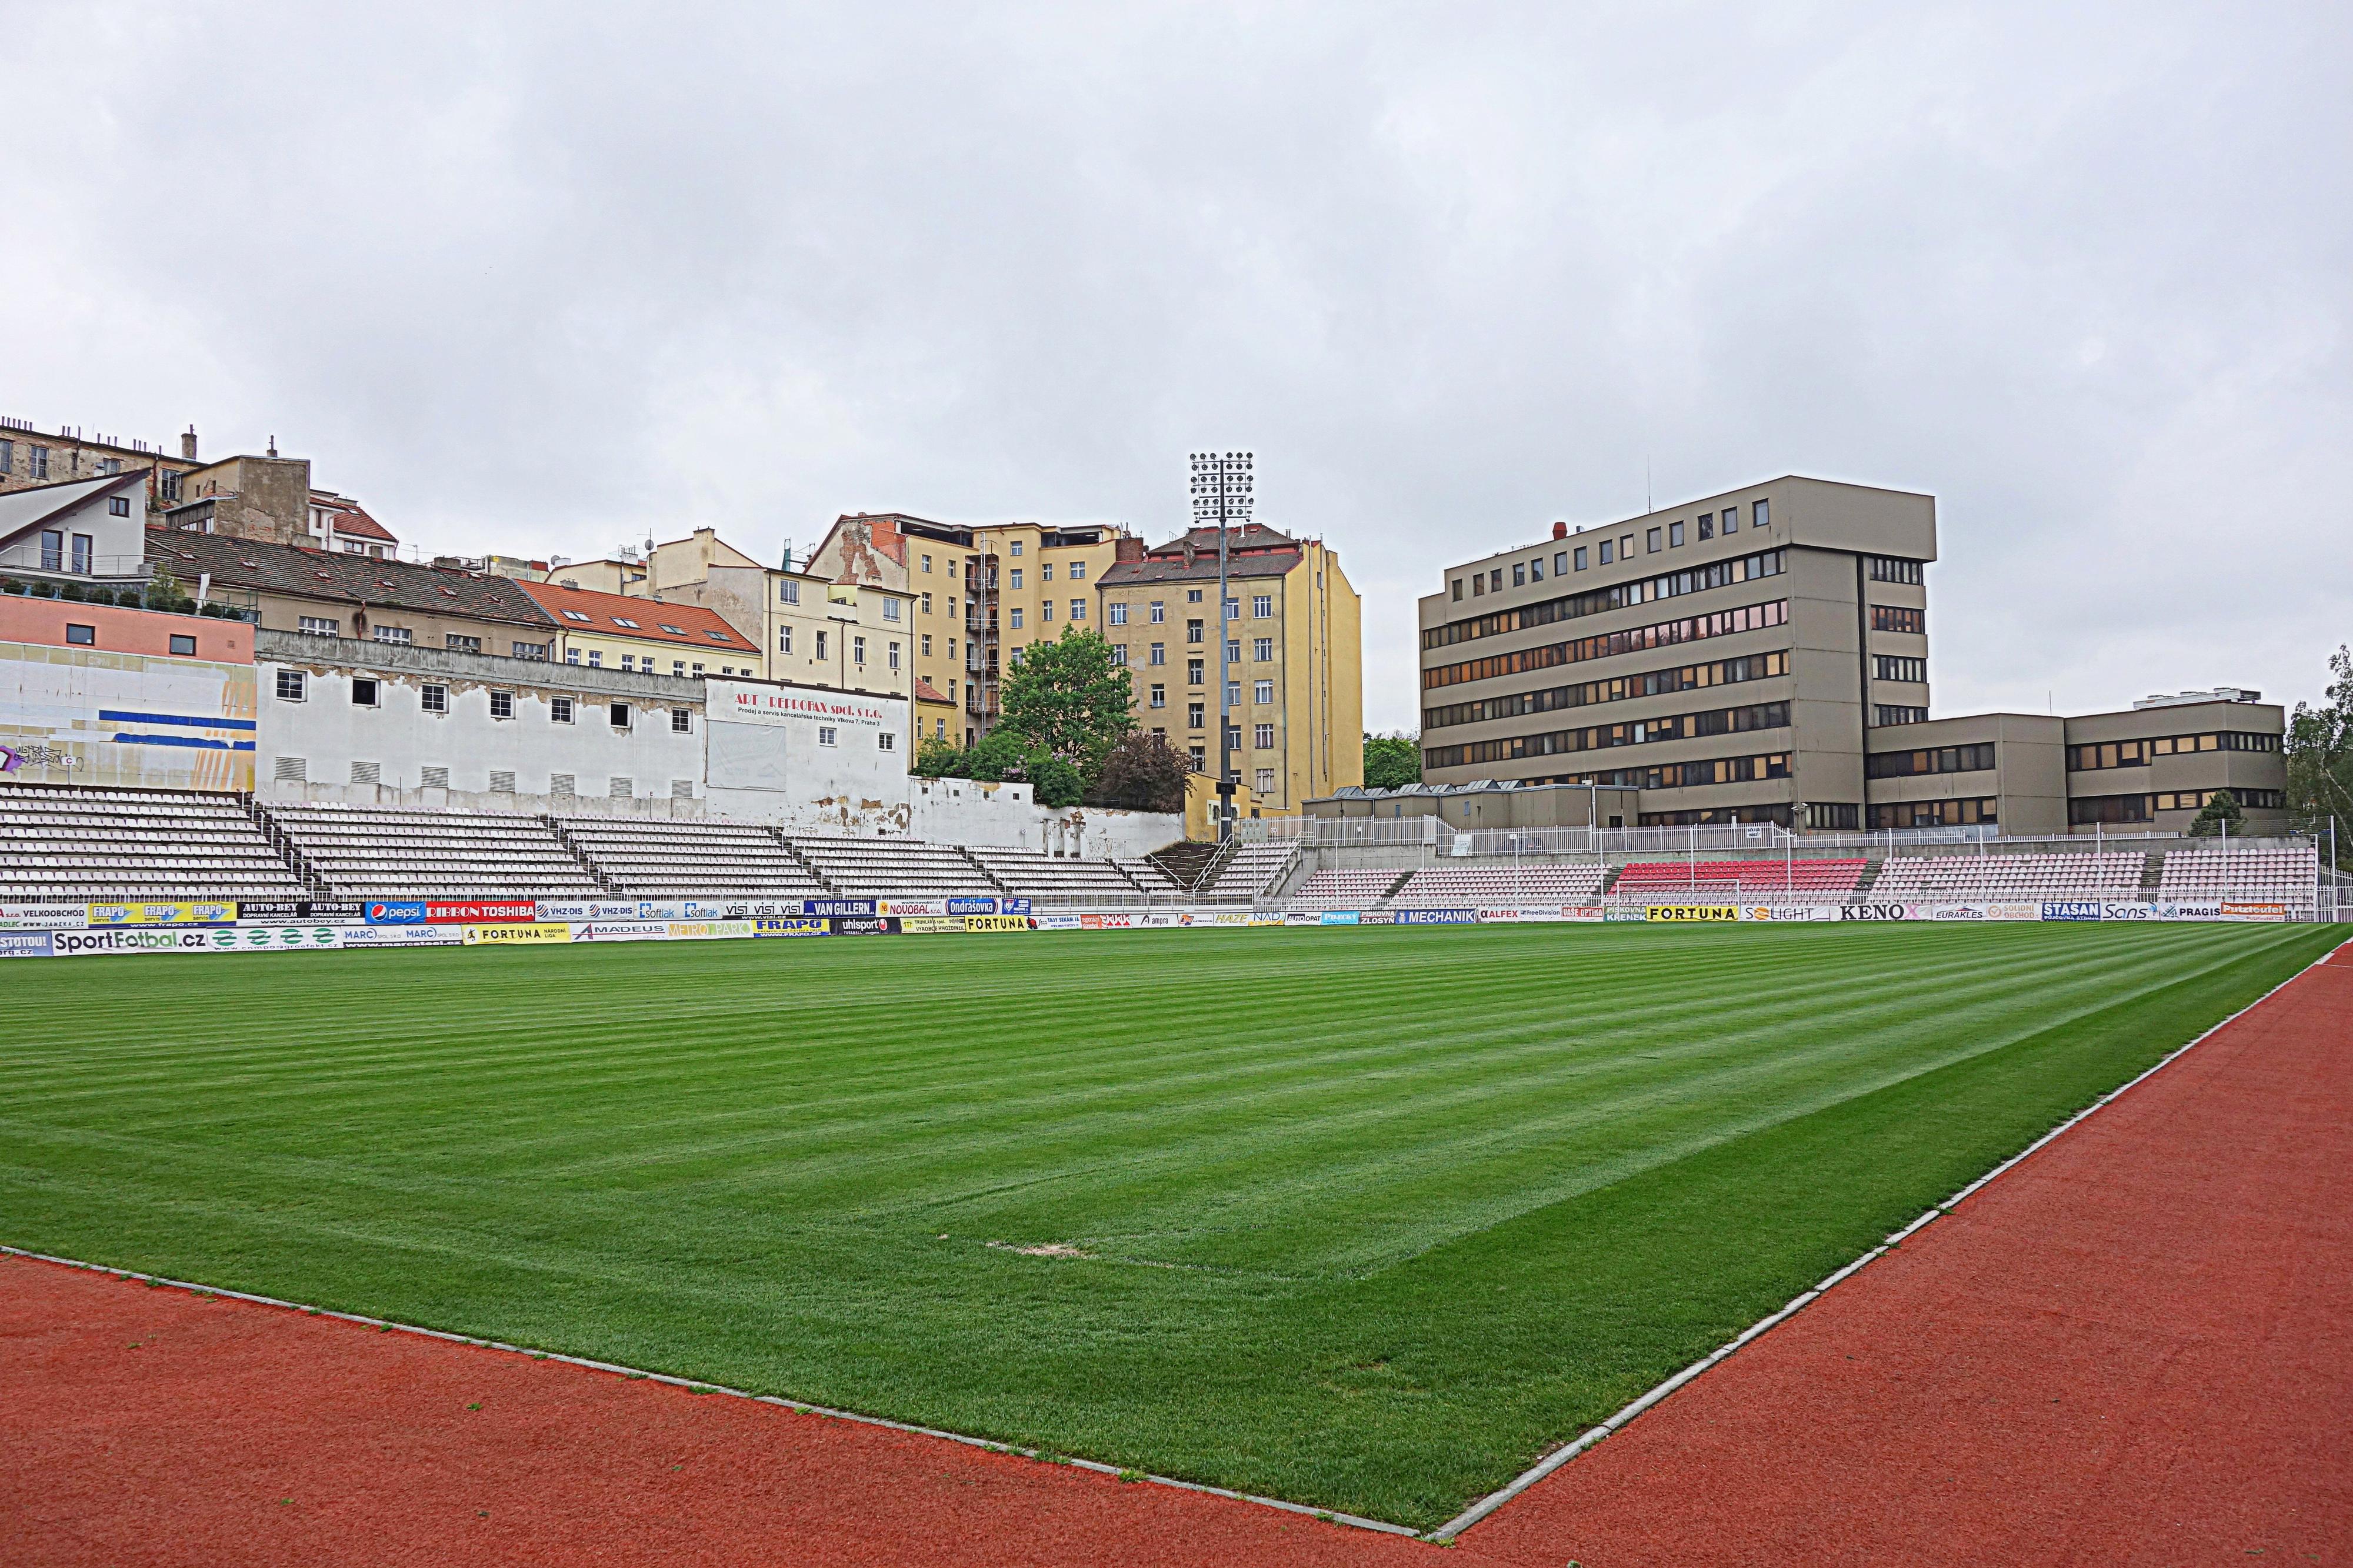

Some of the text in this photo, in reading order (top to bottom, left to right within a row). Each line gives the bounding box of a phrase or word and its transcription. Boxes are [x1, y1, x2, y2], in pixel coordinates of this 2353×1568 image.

[734, 693, 758, 706] ART
[769, 696, 828, 713] REPROFAX
[831, 705, 855, 716] spol.
[857, 708, 862, 717] s
[865, 709, 882, 719] r.o.
[781, 711, 812, 720] kancelářské
[814, 715, 836, 723] techniky
[93, 906, 125, 918] FRAPO
[144, 905, 175, 916] FRAPO
[192, 905, 222, 915] FRAPO
[242, 903, 298, 912] AUTO-BEY
[310, 903, 362, 911] AUTO-BEY
[426, 906, 535, 918] RIBBON TOSHIBA
[890, 905, 929, 915] NOVOBAL
[950, 900, 994, 913] Ondrášovka
[1580, 908, 1602, 916] OPTIKA
[1839, 904, 1921, 920] KENOX
[2004, 903, 2034, 912] SOLIDNÍ
[2044, 903, 2099, 916] STASAN
[2102, 903, 2148, 919] Sans
[2179, 908, 2221, 916] PRAGIS
[2223, 905, 2283, 913] Putzteufel
[388, 907, 421, 919] pepsi
[645, 907, 674, 918] softlak
[691, 908, 718, 918] softlak
[1409, 910, 1475, 923] MECHANIK
[1650, 908, 1735, 919] FORTUNA
[968, 918, 1025, 930] FORTUNA
[1152, 917, 1168, 926] ampra
[1215, 914, 1248, 923] HAZE
[715, 923, 745, 936] PARK
[756, 919, 822, 930] FRAPO
[842, 919, 879, 932] uhlsport
[345, 930, 375, 939] MARC
[406, 930, 434, 939] MARC
[482, 929, 541, 939] FORTUNA
[55, 932, 206, 953] SportFotbal.cz
